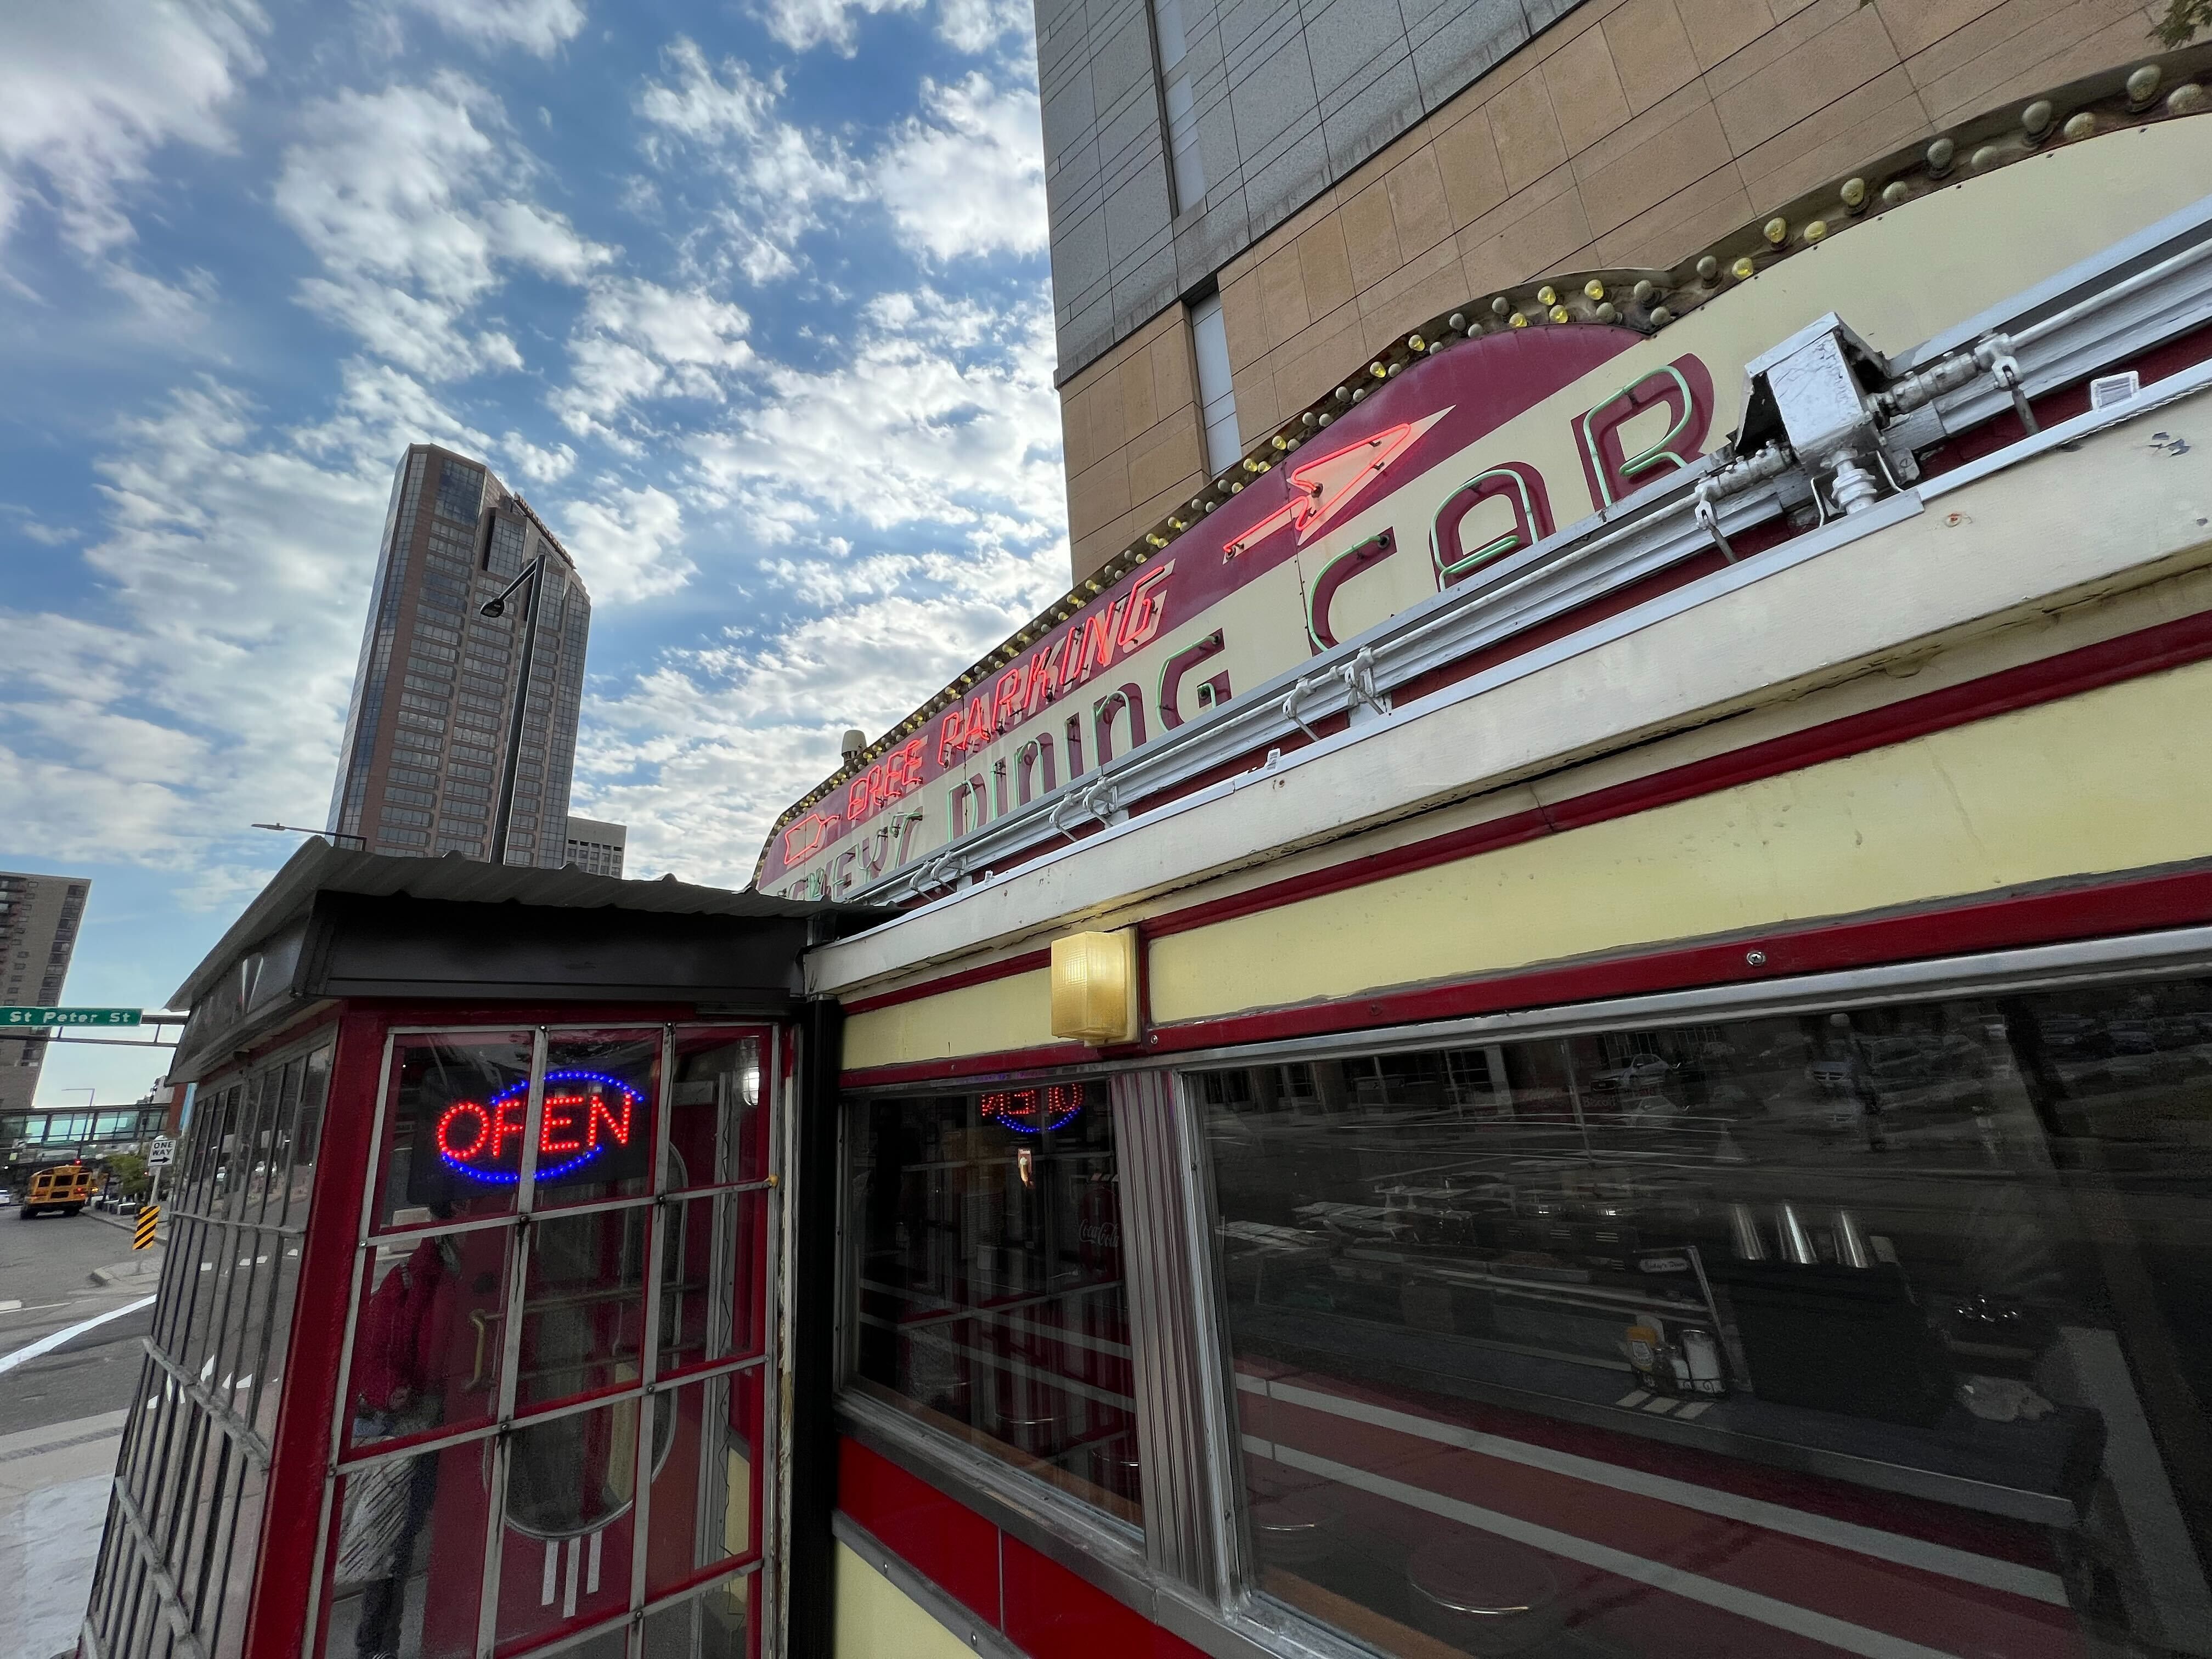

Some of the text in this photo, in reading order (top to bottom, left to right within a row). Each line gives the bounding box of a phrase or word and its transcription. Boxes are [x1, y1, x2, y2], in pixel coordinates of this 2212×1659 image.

[847, 559, 1175, 821] FREE PARKING
[9, 1011, 131, 1023] St Peter St
[437, 1093, 631, 1161] OPEN
